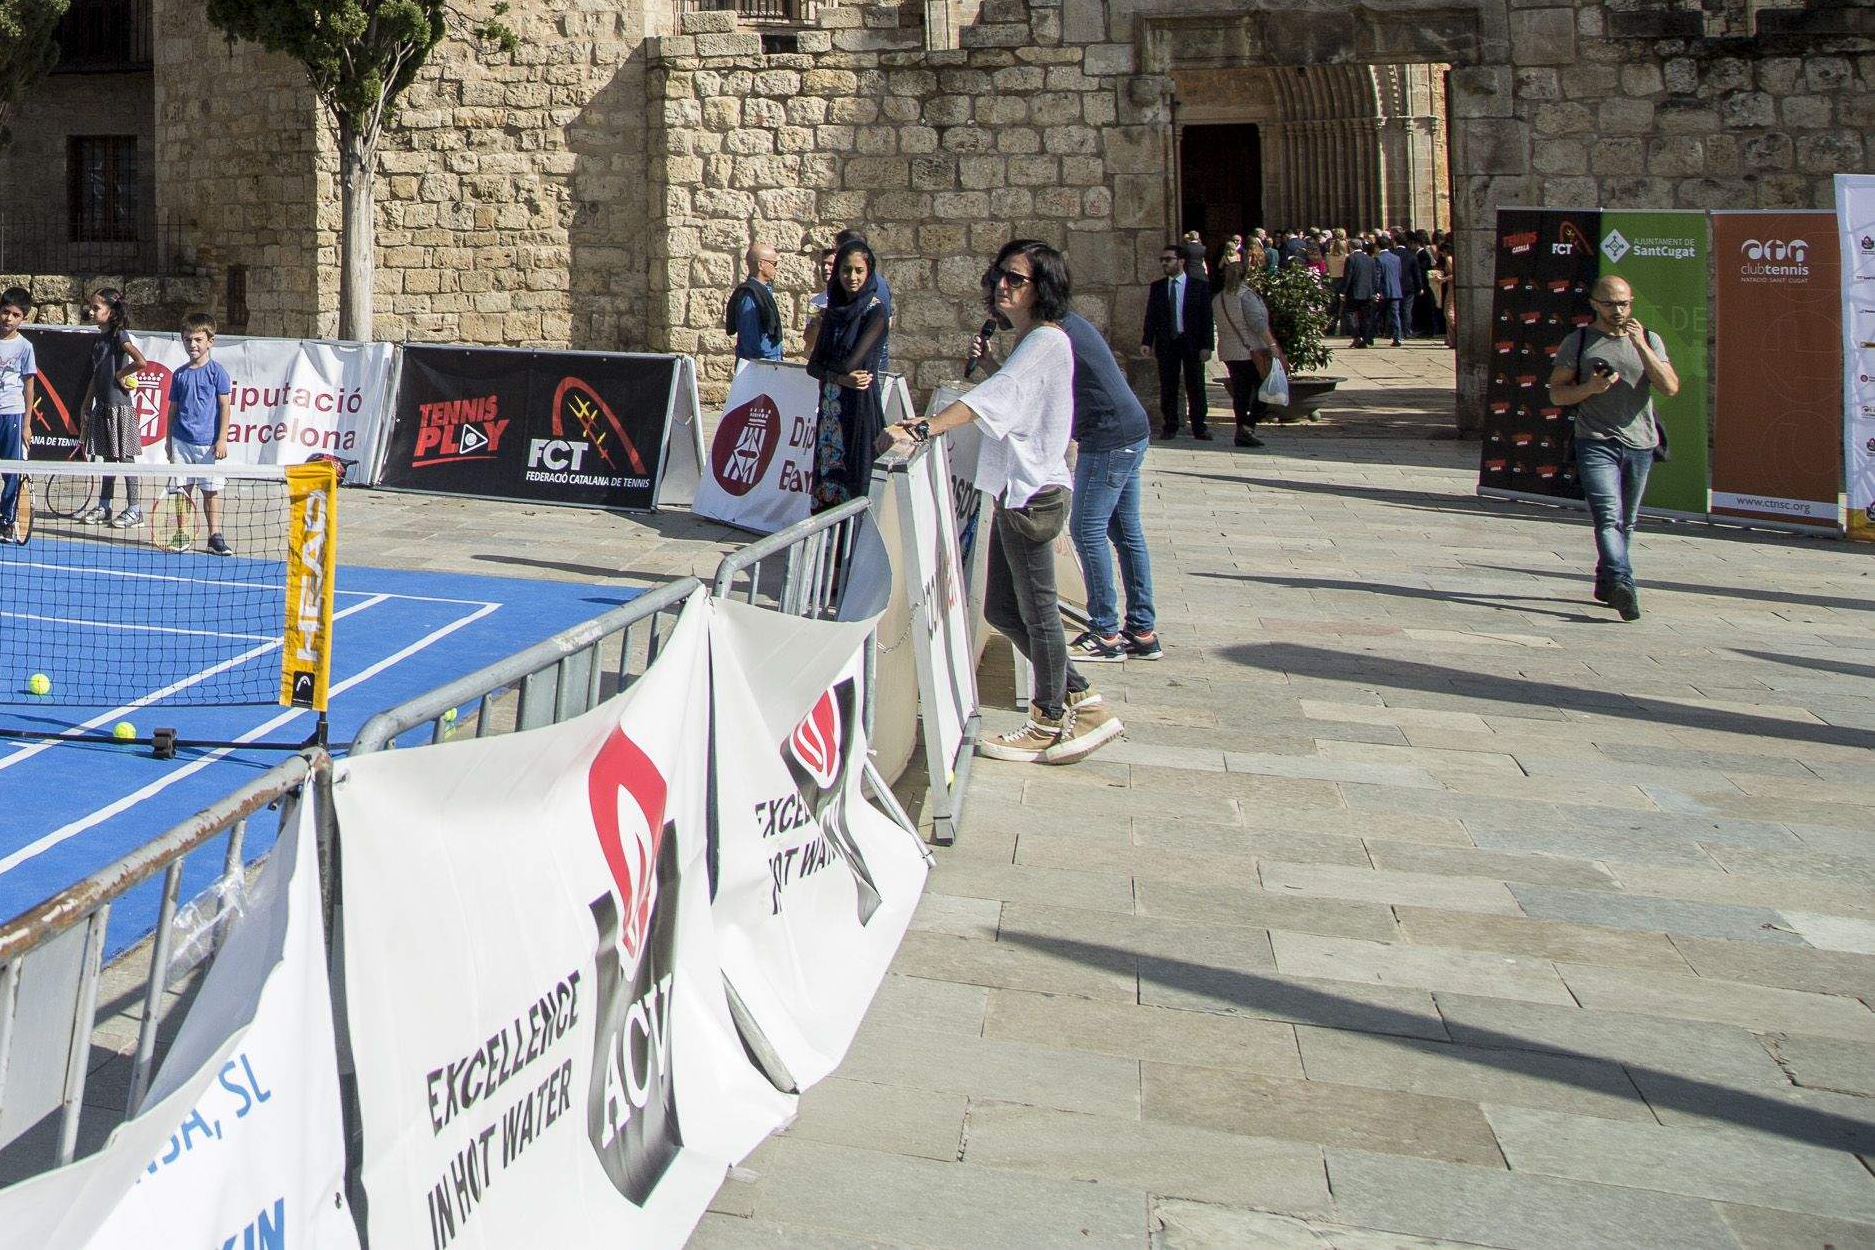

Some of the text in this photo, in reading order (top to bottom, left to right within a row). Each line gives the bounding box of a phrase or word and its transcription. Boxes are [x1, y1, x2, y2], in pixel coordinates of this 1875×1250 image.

[1552, 243, 1573, 255] FCT
[1633, 246, 1696, 259] SantCugat
[1684, 238, 1695, 246] DE
[230, 380, 363, 414] iputació
[419, 394, 499, 428] TENNIS
[46, 437, 57, 446] DE
[226, 418, 356, 450] arcelona
[527, 438, 589, 471] FCT
[526, 470, 650, 489] FEDERACIÓ CATALANA DE TENNIS
[296, 489, 327, 662] HEAD
[426, 969, 581, 1138] EXCELLENCE
[601, 972, 672, 1150] ACV
[218, 1053, 272, 1119] SL
[427, 1058, 572, 1250] IN HOT WATER
